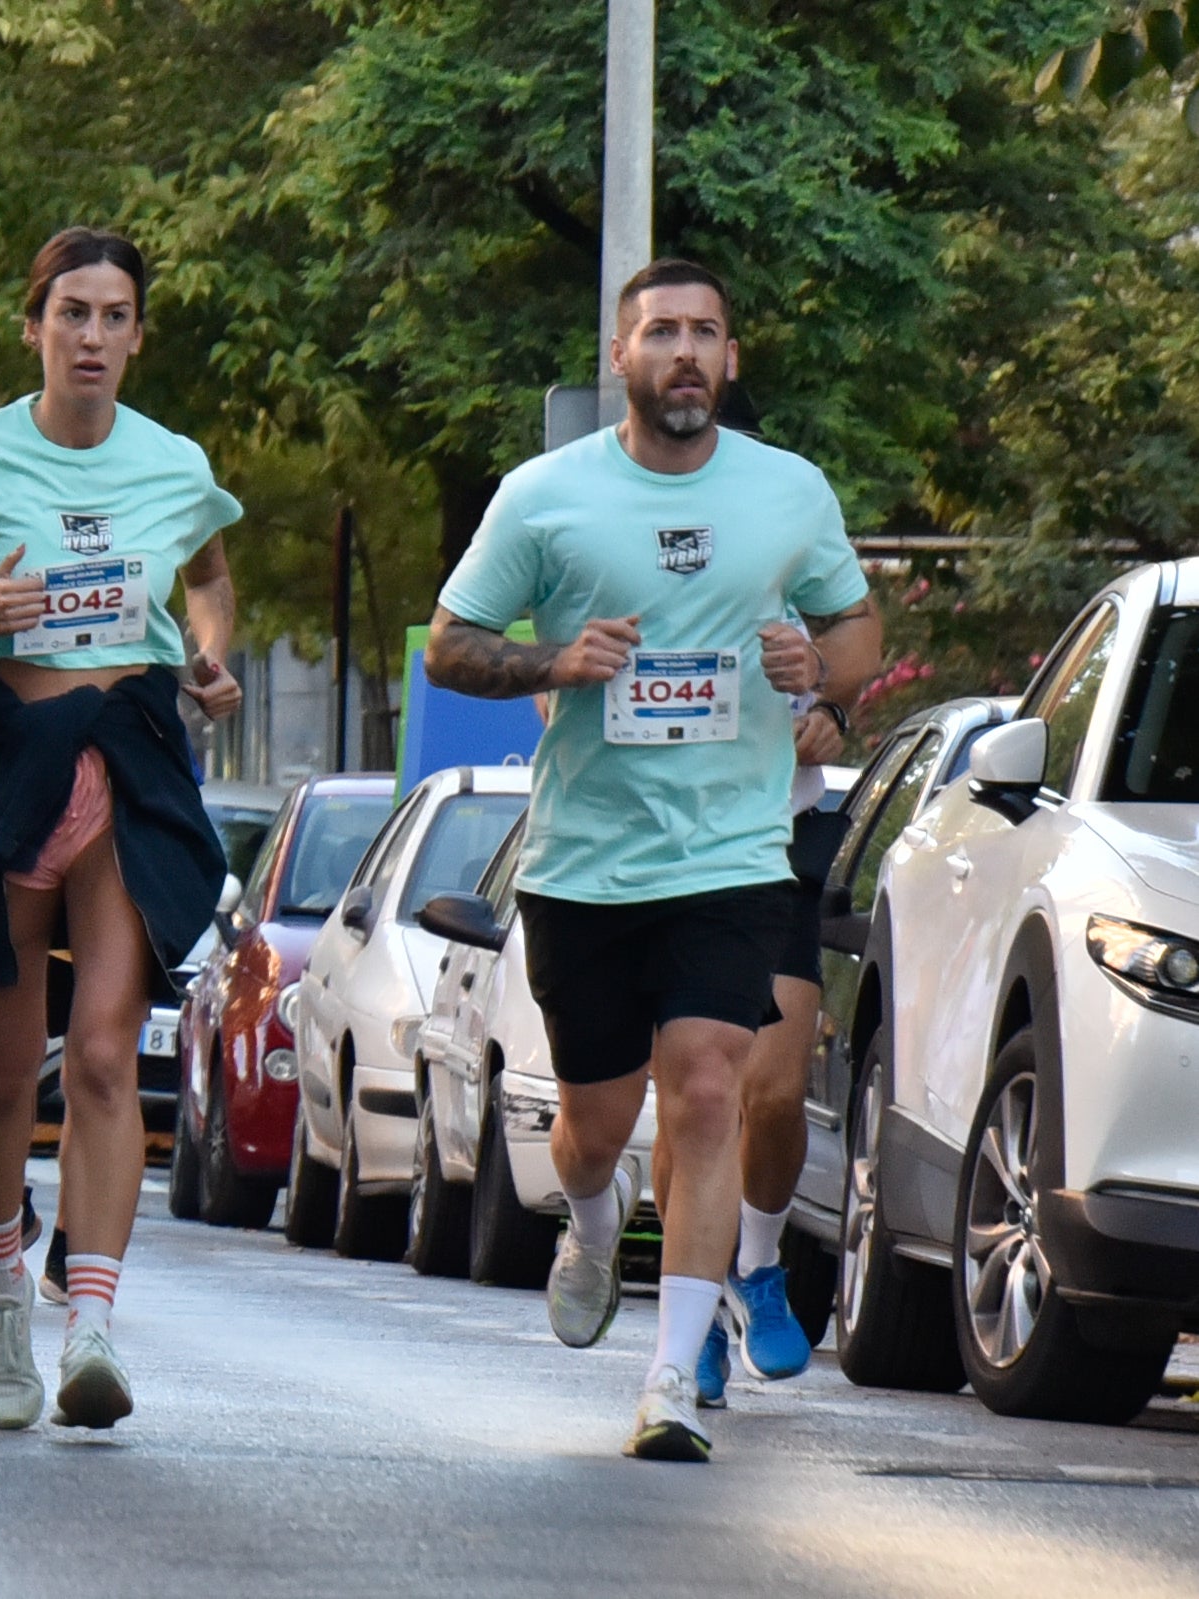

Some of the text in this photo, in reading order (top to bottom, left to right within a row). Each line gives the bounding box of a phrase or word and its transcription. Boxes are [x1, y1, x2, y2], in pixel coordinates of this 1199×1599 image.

[62, 533, 113, 551] HYBRID
[658, 545, 713, 569] HYBRID
[43, 587, 124, 615] 1042
[629, 679, 716, 702] 1044
